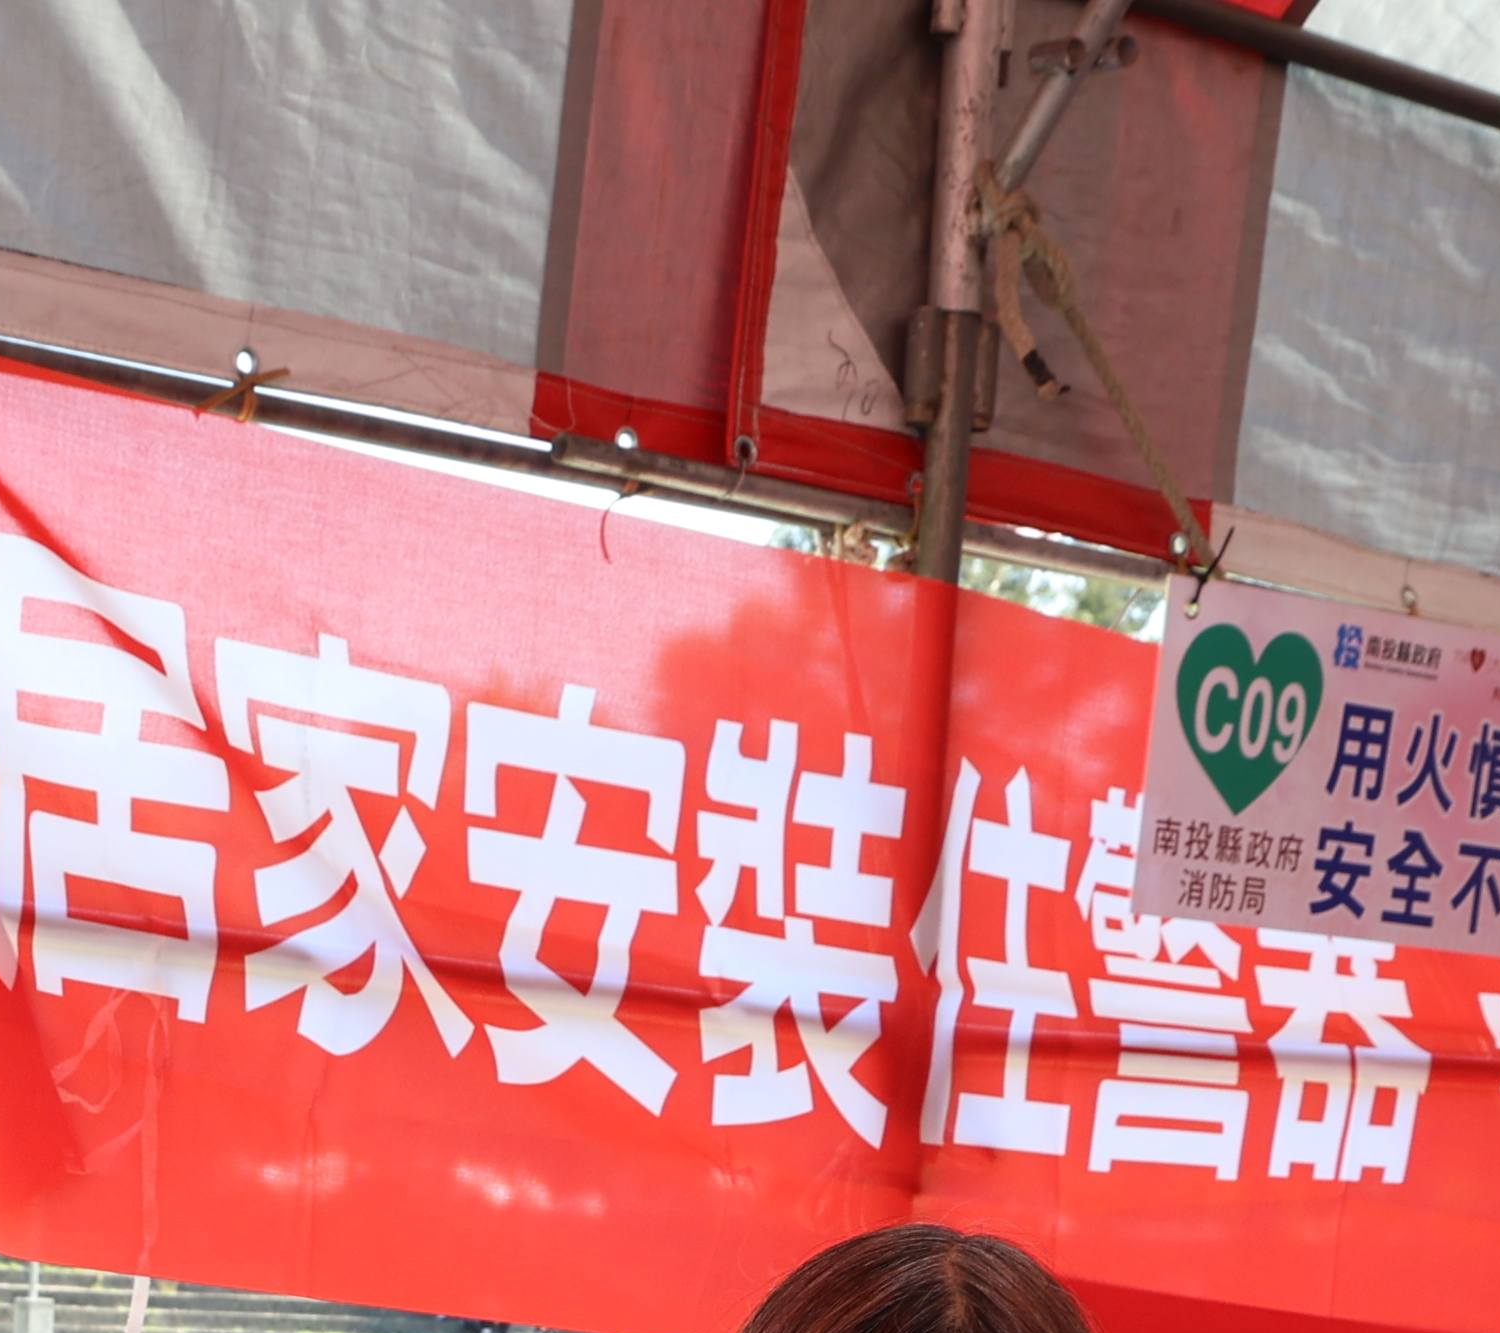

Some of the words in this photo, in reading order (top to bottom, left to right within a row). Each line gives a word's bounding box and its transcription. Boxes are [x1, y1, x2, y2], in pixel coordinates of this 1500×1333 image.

[1194, 664, 1309, 765] C09
[1153, 818, 1304, 873] 南投縣政府
[1178, 868, 1267, 915] 消防局
